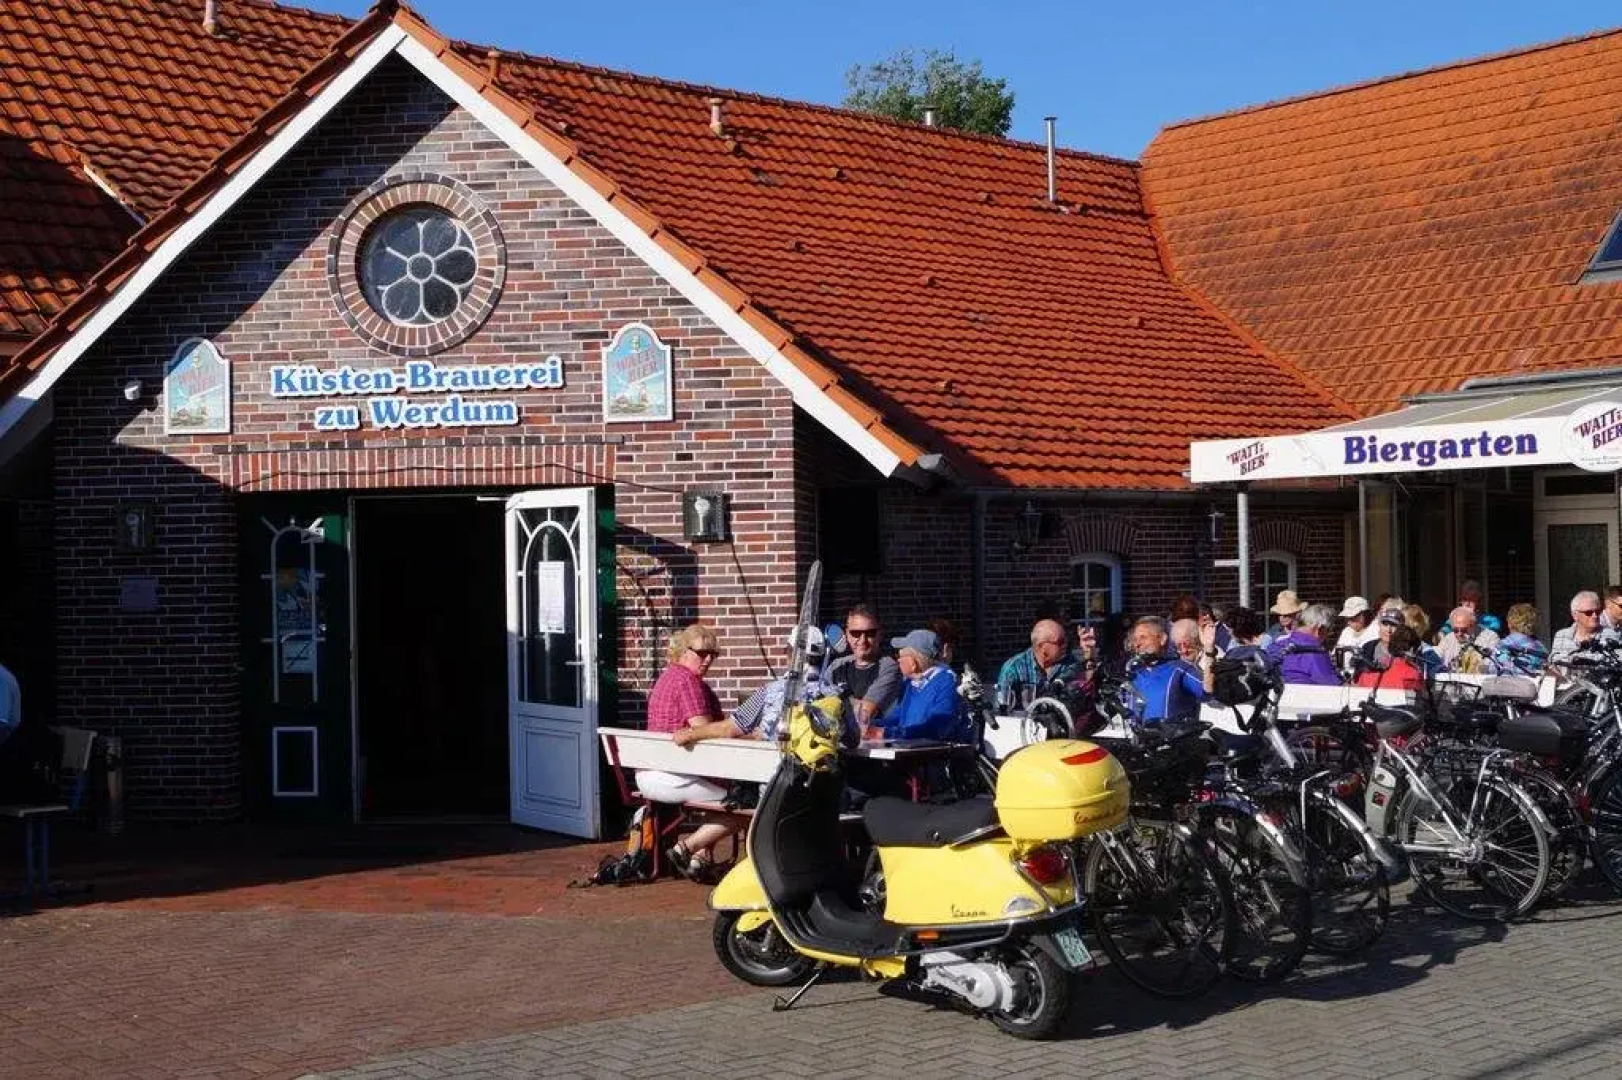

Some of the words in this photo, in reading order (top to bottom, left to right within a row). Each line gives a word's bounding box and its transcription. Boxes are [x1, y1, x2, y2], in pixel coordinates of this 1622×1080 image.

[273, 359, 561, 394] Küsten-Brauerei
[317, 408, 356, 426] zu
[370, 396, 515, 424] Werdum
[1343, 430, 1538, 468] Biergarten
